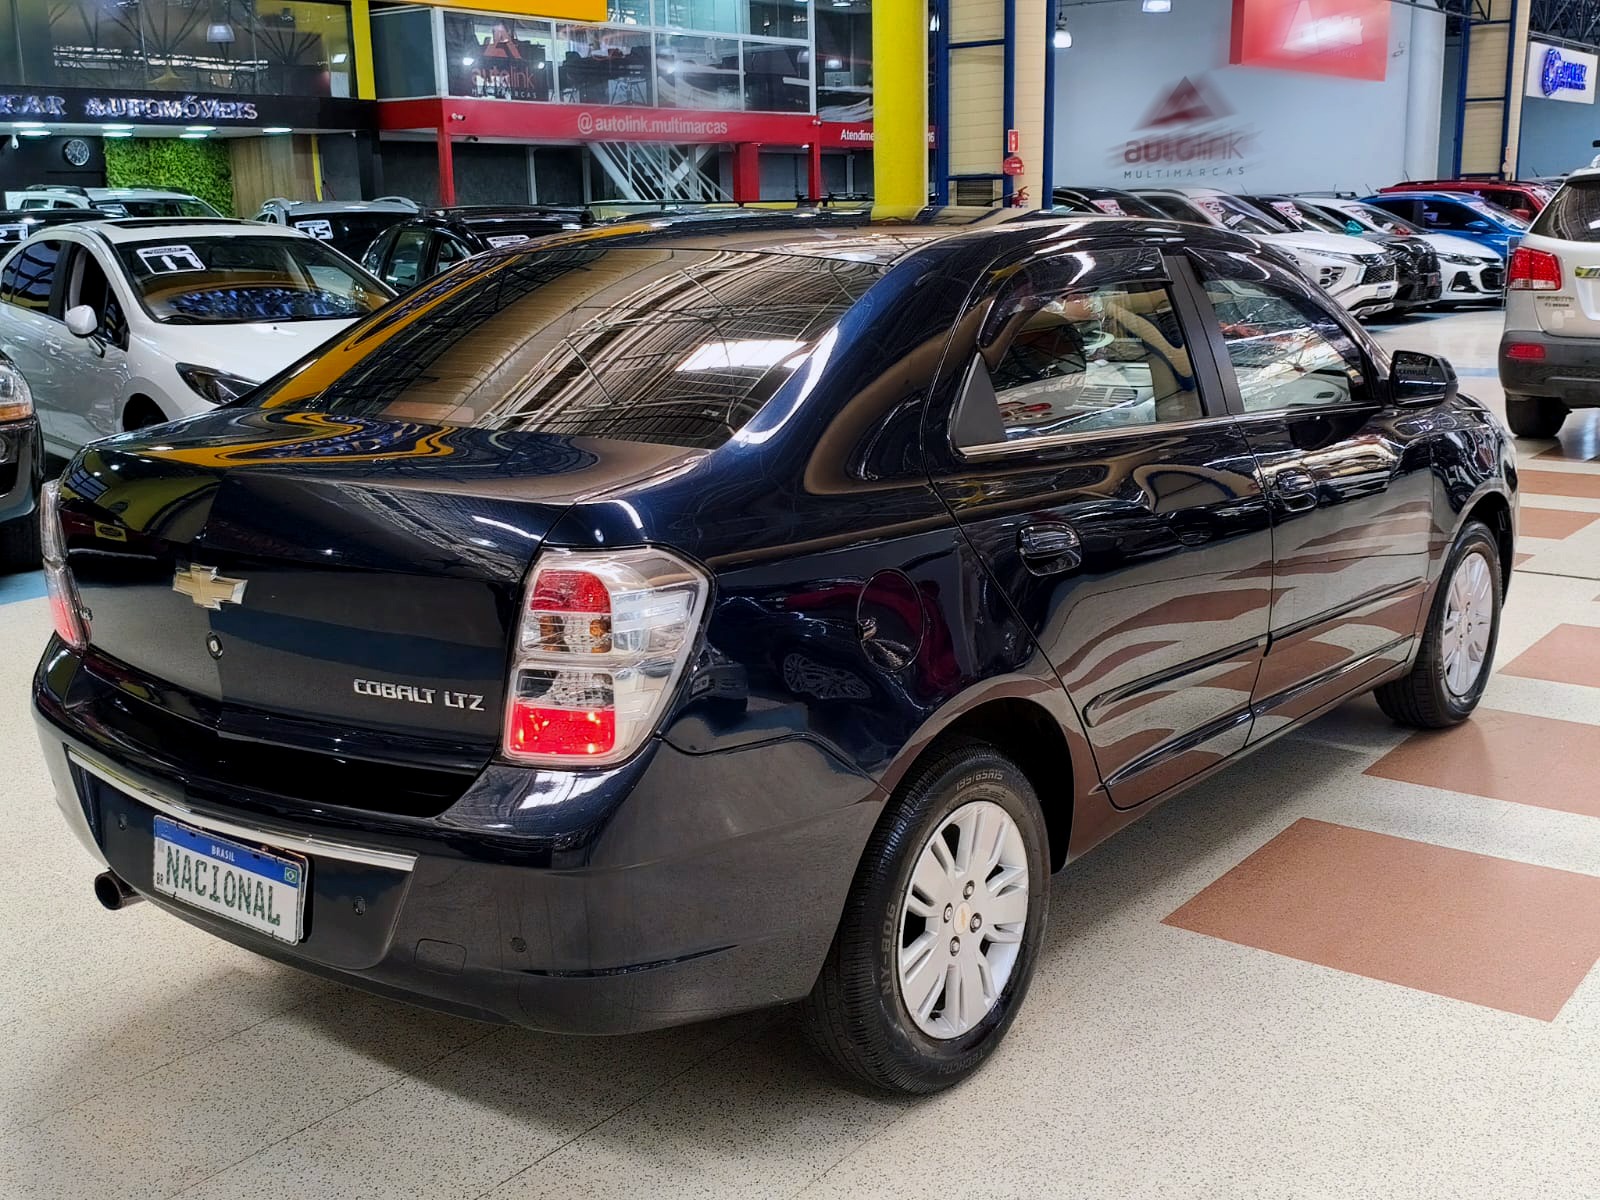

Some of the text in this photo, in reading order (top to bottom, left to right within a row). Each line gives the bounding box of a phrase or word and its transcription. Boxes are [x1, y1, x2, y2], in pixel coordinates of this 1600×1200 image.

[1123, 166, 1245, 180] MULTIMARCAS
[353, 678, 485, 711] COBALT LTZ
[211, 845, 236, 862] BRASIL
[166, 845, 281, 927] NACIONAL
